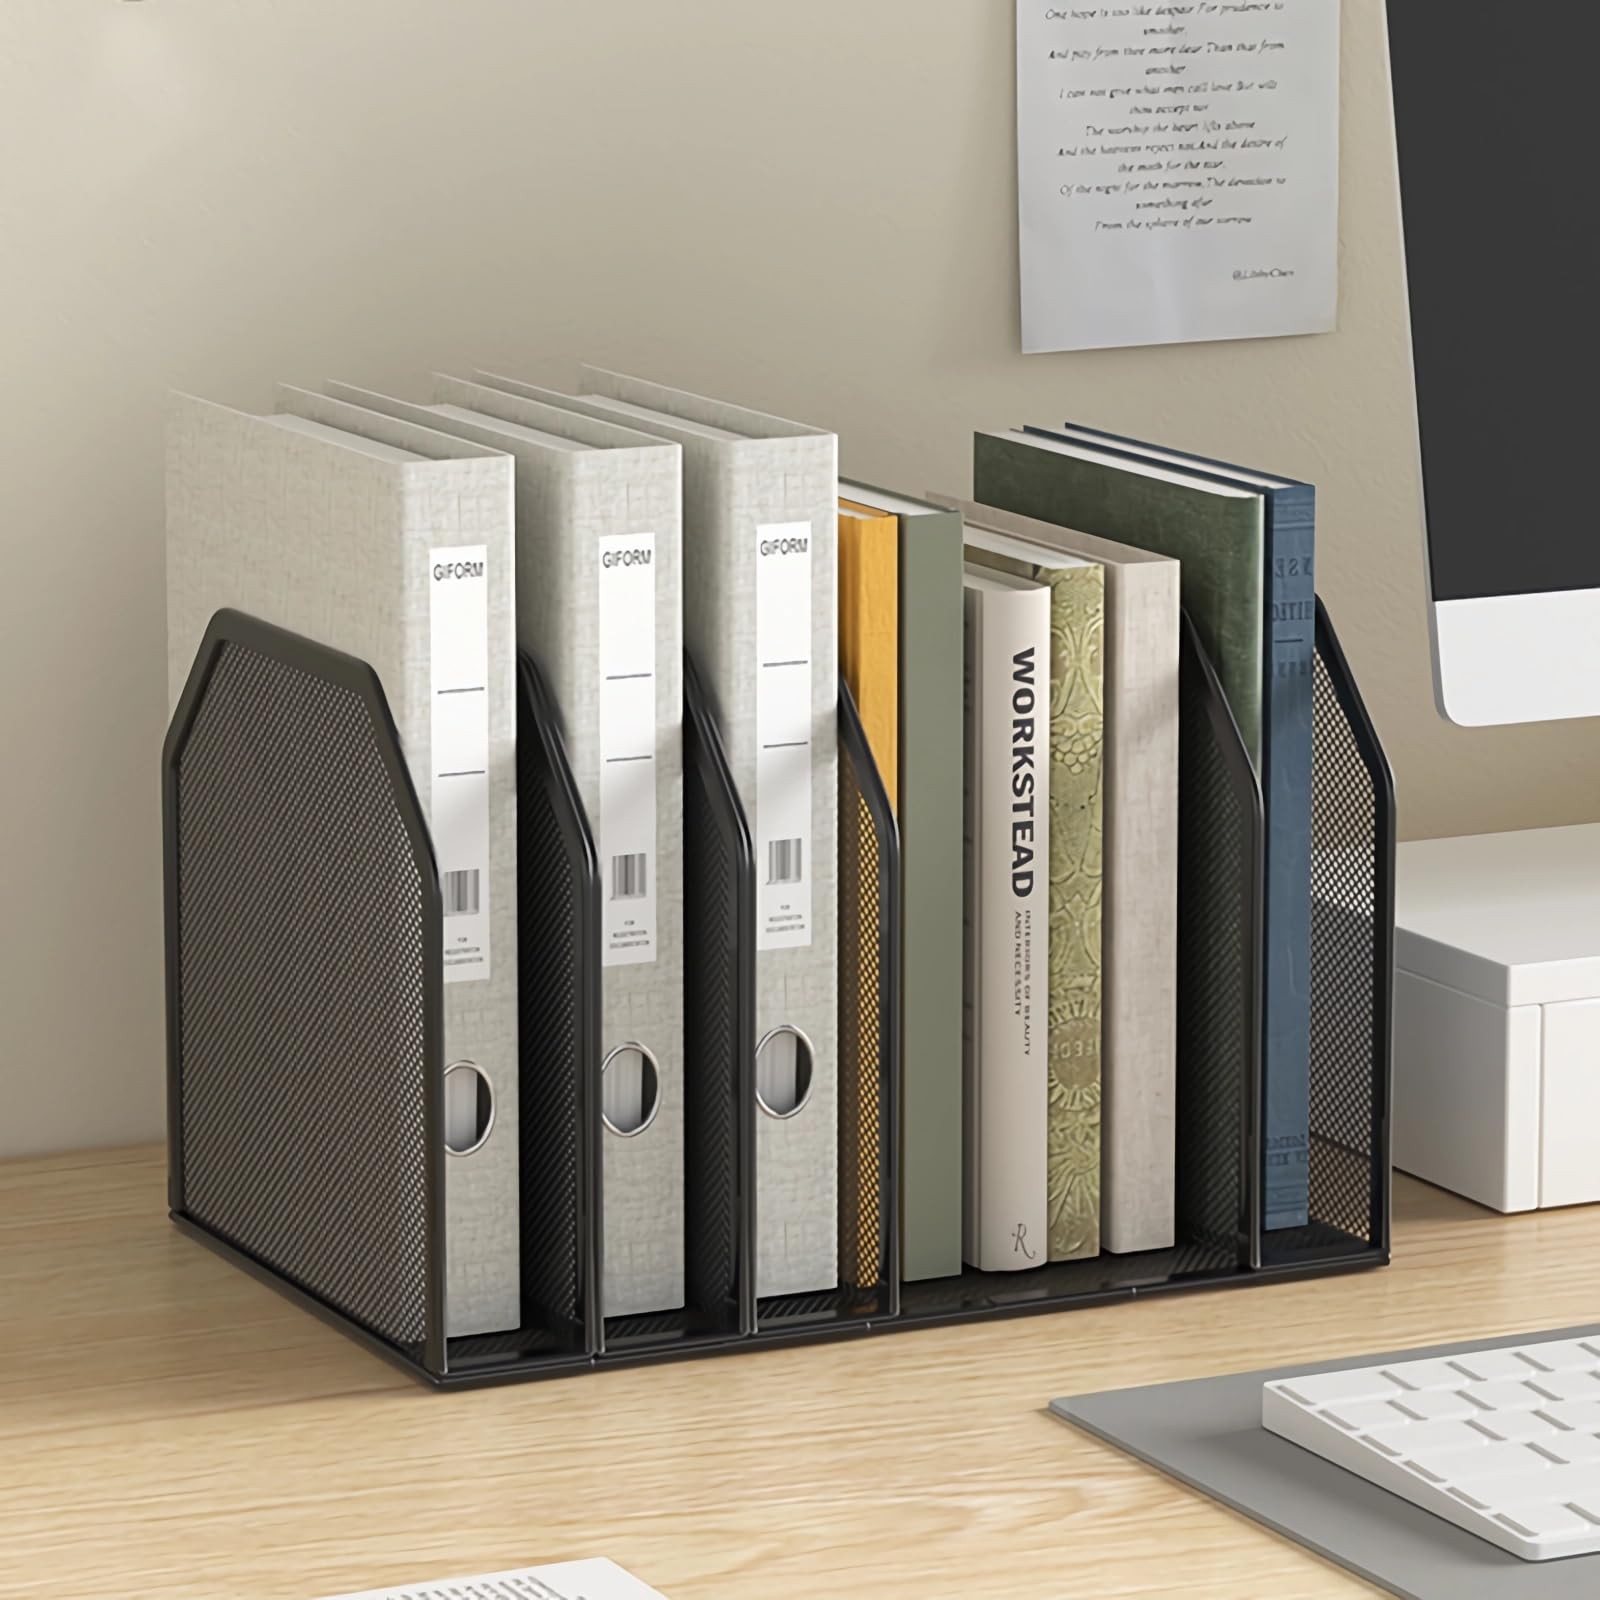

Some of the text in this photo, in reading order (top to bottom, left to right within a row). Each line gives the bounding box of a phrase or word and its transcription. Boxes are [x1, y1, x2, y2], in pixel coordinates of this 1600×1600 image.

[1011, 647, 1035, 898] WORKSTEAD
[1014, 943, 1022, 1016] NECESSITY
[1024, 985, 1031, 1000] OF
